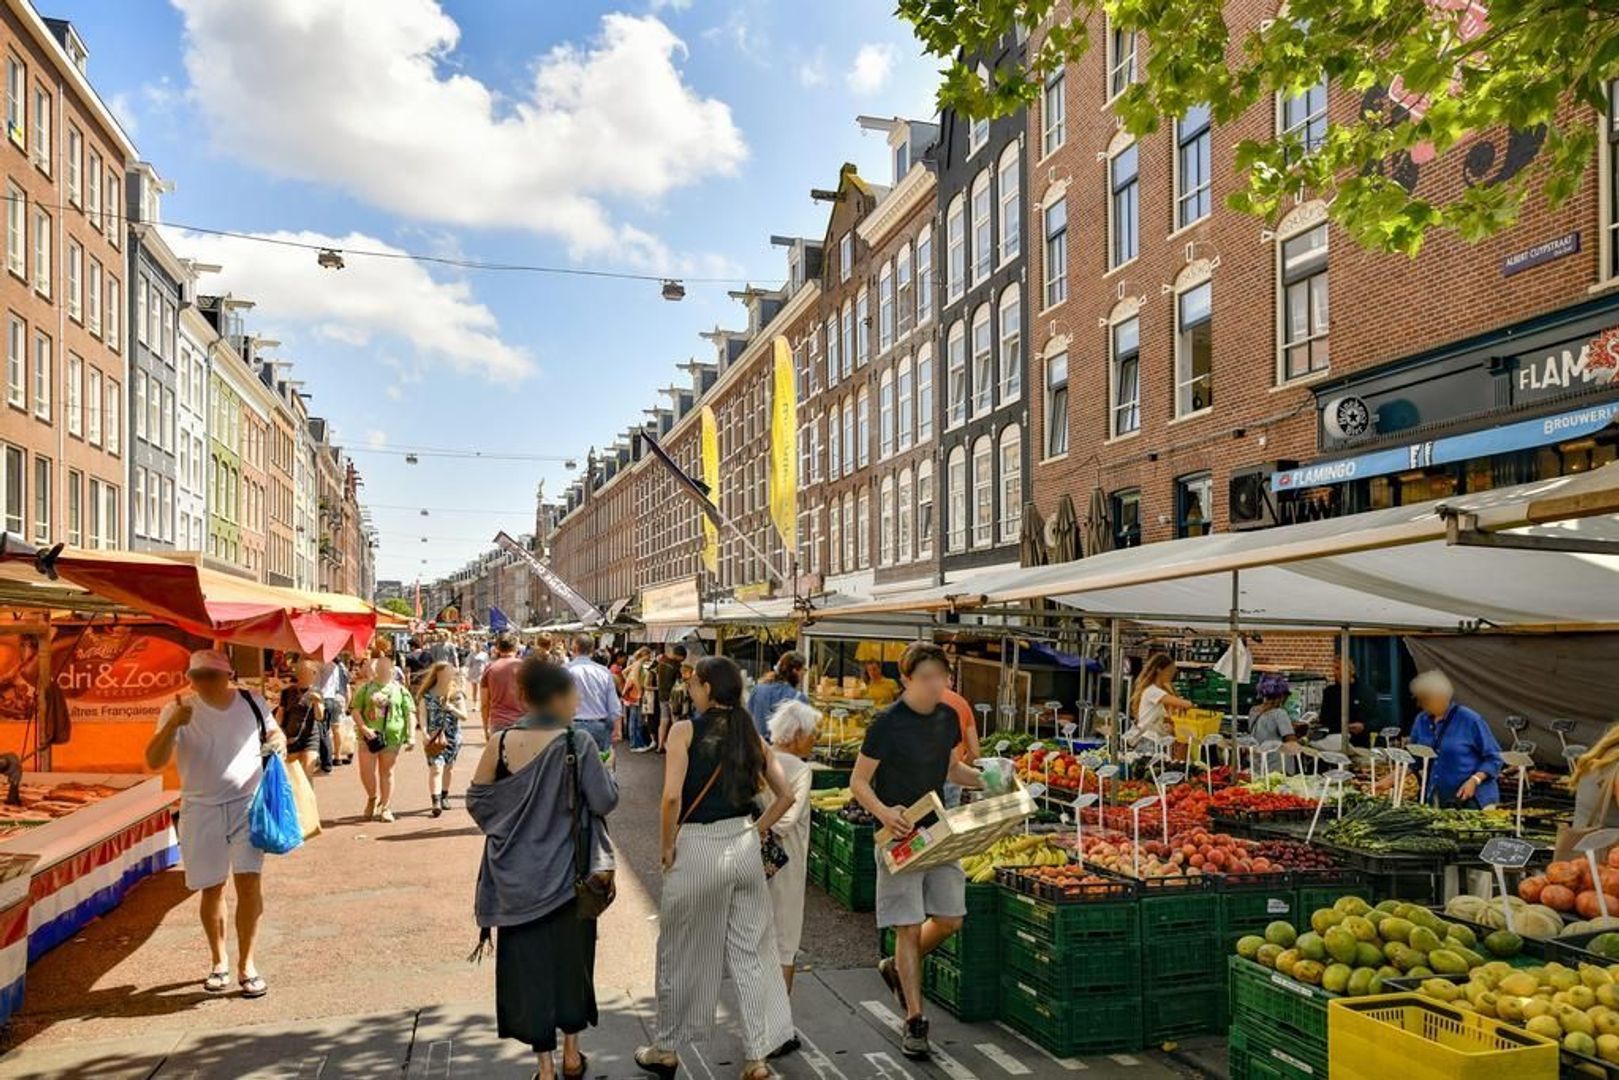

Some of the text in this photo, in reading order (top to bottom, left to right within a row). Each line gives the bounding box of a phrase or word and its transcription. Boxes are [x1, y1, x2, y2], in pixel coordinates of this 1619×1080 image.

[1293, 462, 1355, 487] FLAMINGO
[51, 664, 92, 689] dri
[95, 663, 118, 688] &
[101, 704, 161, 717] Françaises
